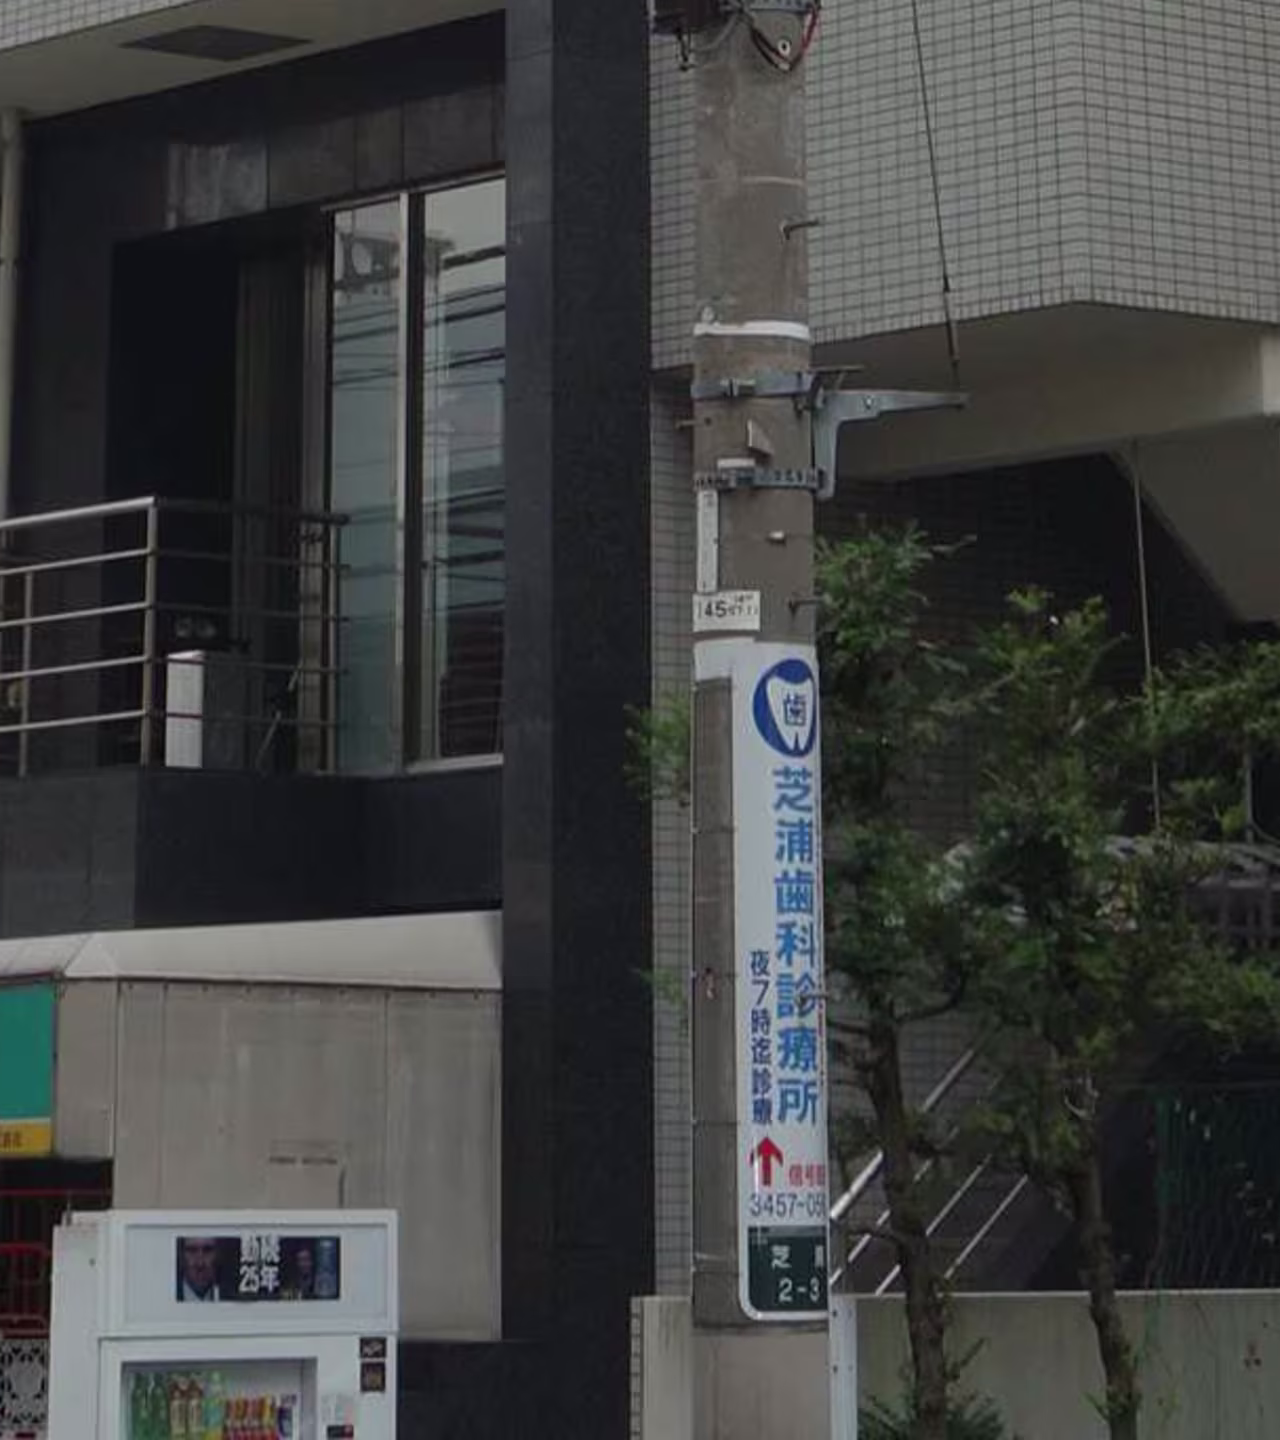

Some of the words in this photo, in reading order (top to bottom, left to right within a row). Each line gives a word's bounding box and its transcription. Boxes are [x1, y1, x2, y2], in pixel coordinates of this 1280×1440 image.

[783, 693, 807, 727] 歯
[773, 765, 818, 1127] 芝浦歯科診療所
[238, 1264, 281, 1293] 25年
